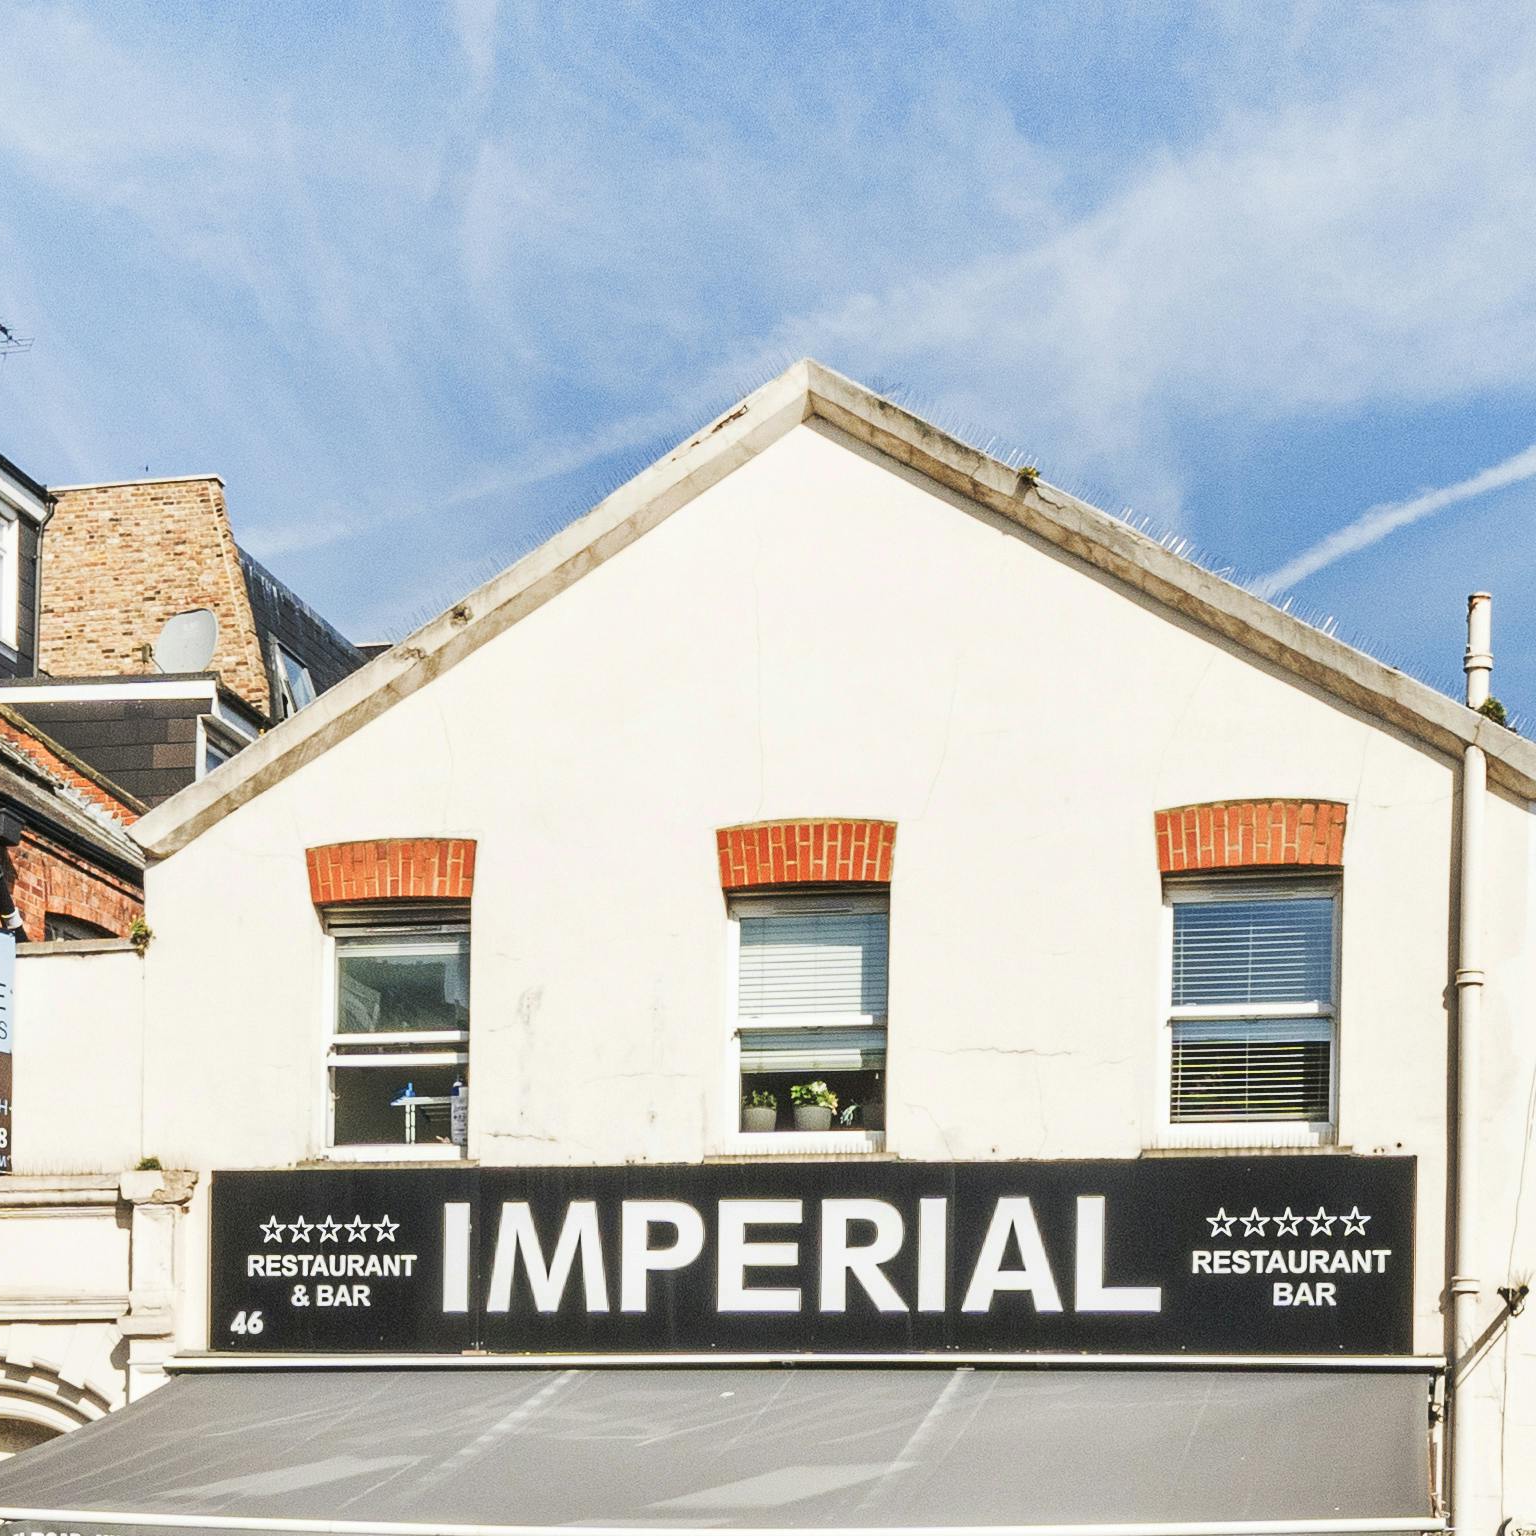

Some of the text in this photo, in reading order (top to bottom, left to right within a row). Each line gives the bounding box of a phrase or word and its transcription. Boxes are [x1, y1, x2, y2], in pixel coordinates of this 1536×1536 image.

[247, 1254, 417, 1277] RESTAURANT
[443, 1196, 1162, 1312] IMPERIAL
[1192, 1250, 1392, 1274] RESTAURANT
[291, 1284, 371, 1306] & BAR
[1273, 1282, 1337, 1306] BAR
[230, 1310, 264, 1335] 46
